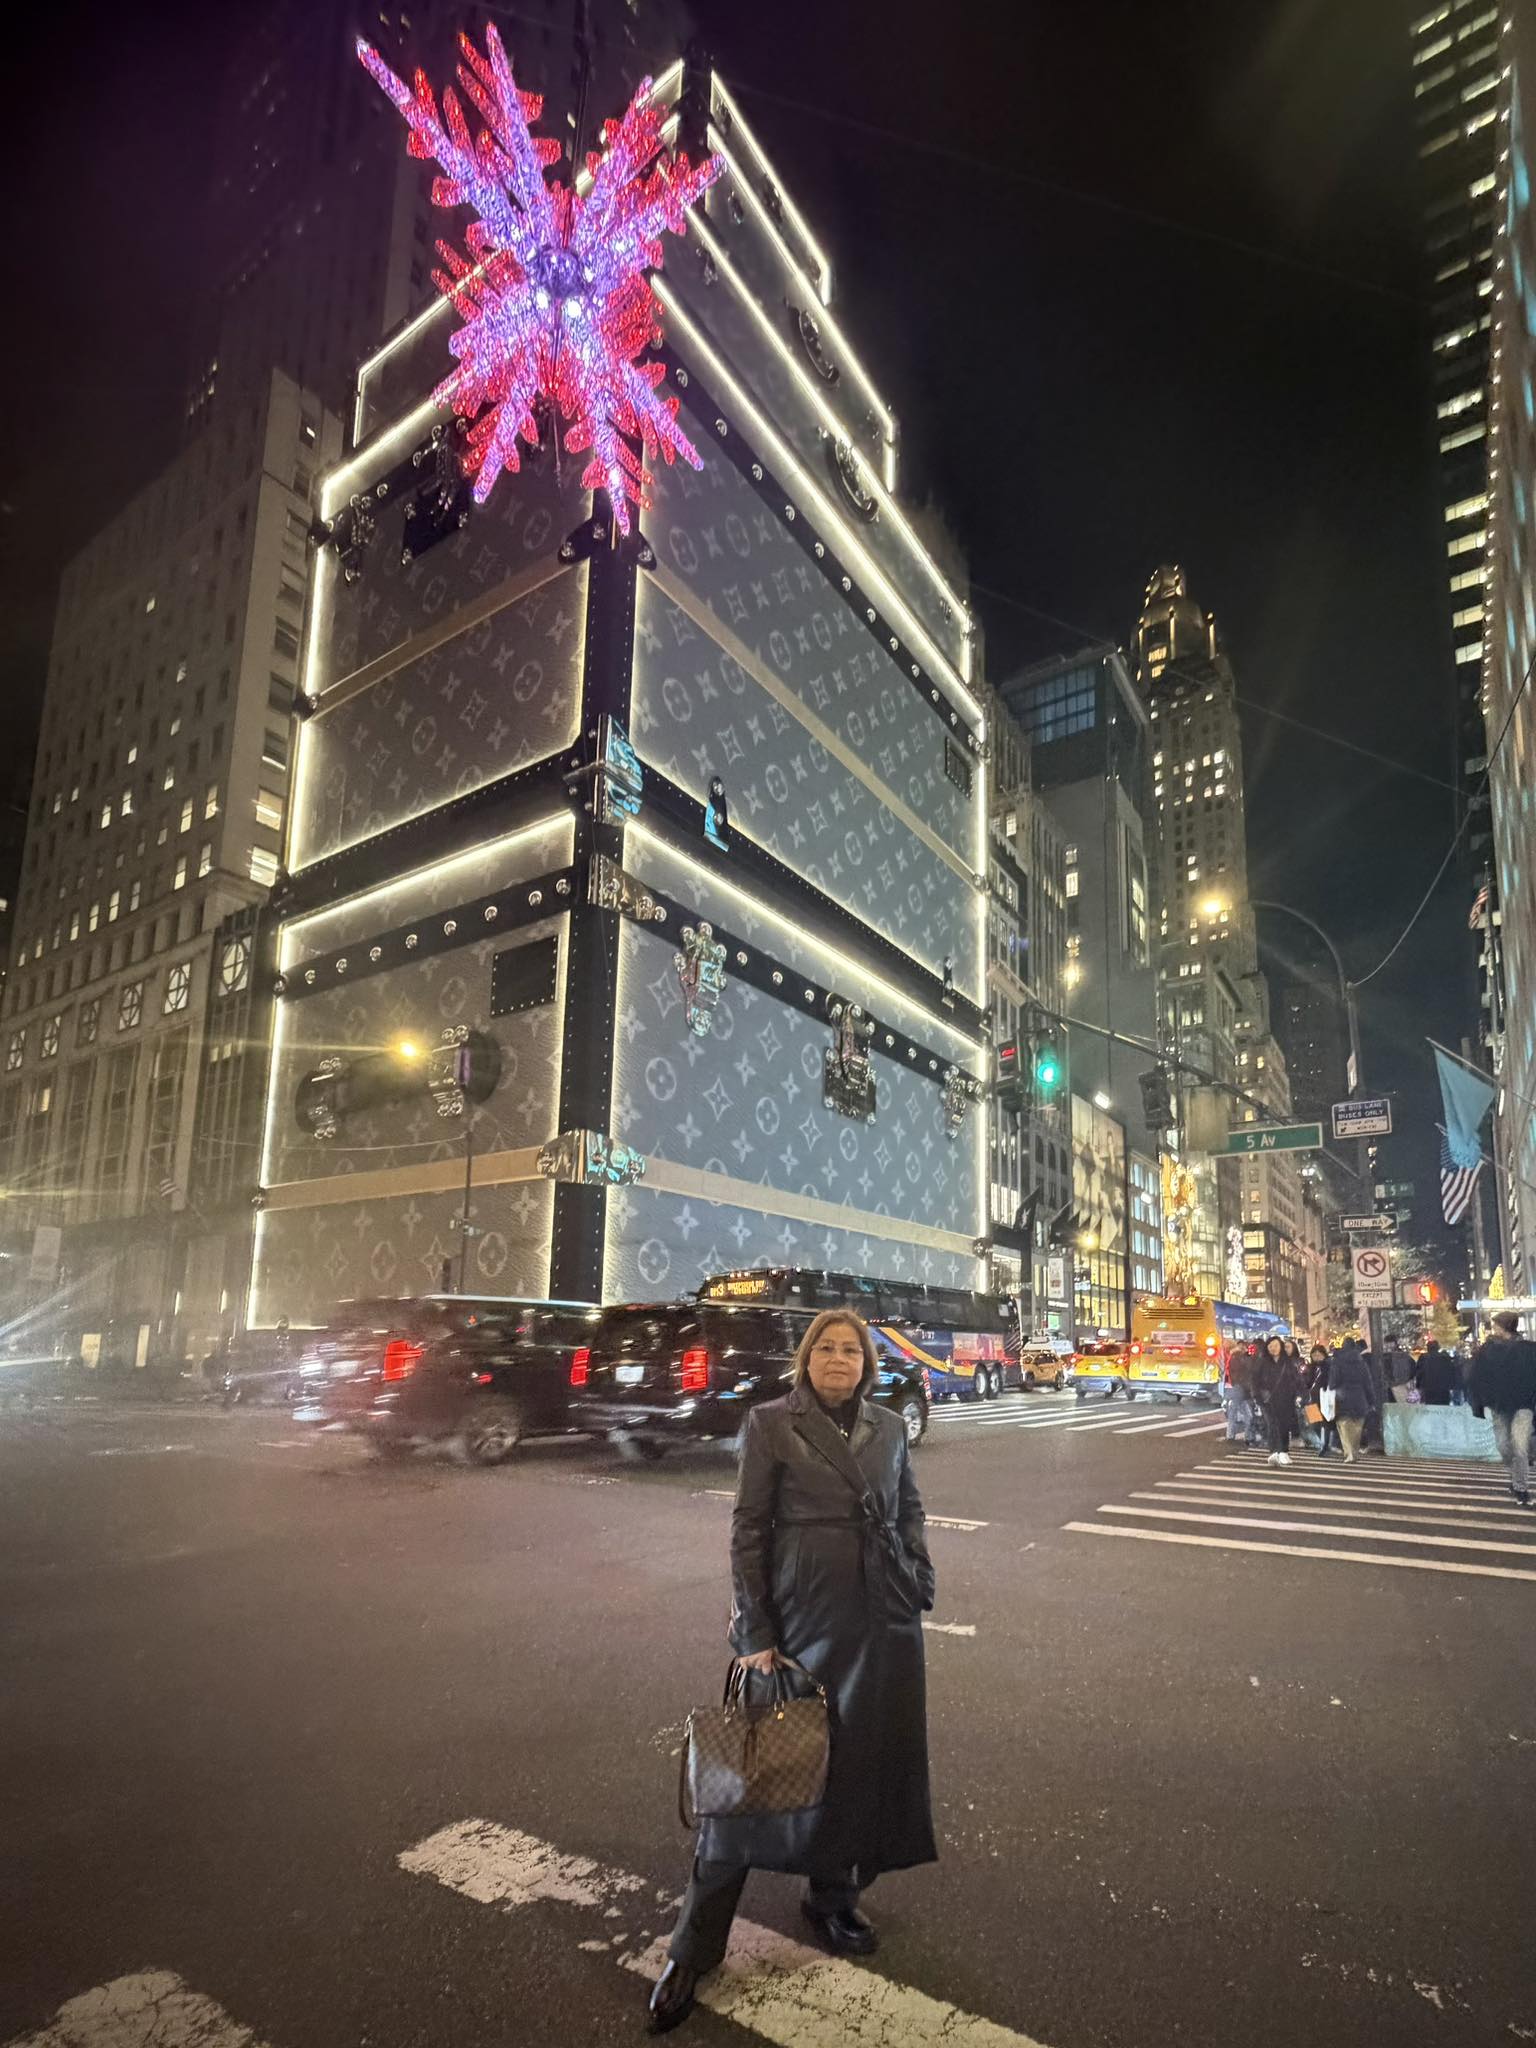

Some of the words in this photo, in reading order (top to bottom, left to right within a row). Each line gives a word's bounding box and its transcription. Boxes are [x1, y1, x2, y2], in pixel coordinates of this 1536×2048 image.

[1364, 1109, 1384, 1117] ONLY
[1246, 1135, 1255, 1149] 5
[1260, 1133, 1276, 1147] Av
[1348, 1219, 1363, 1227] ONE
[1371, 1218, 1389, 1226] WAY
